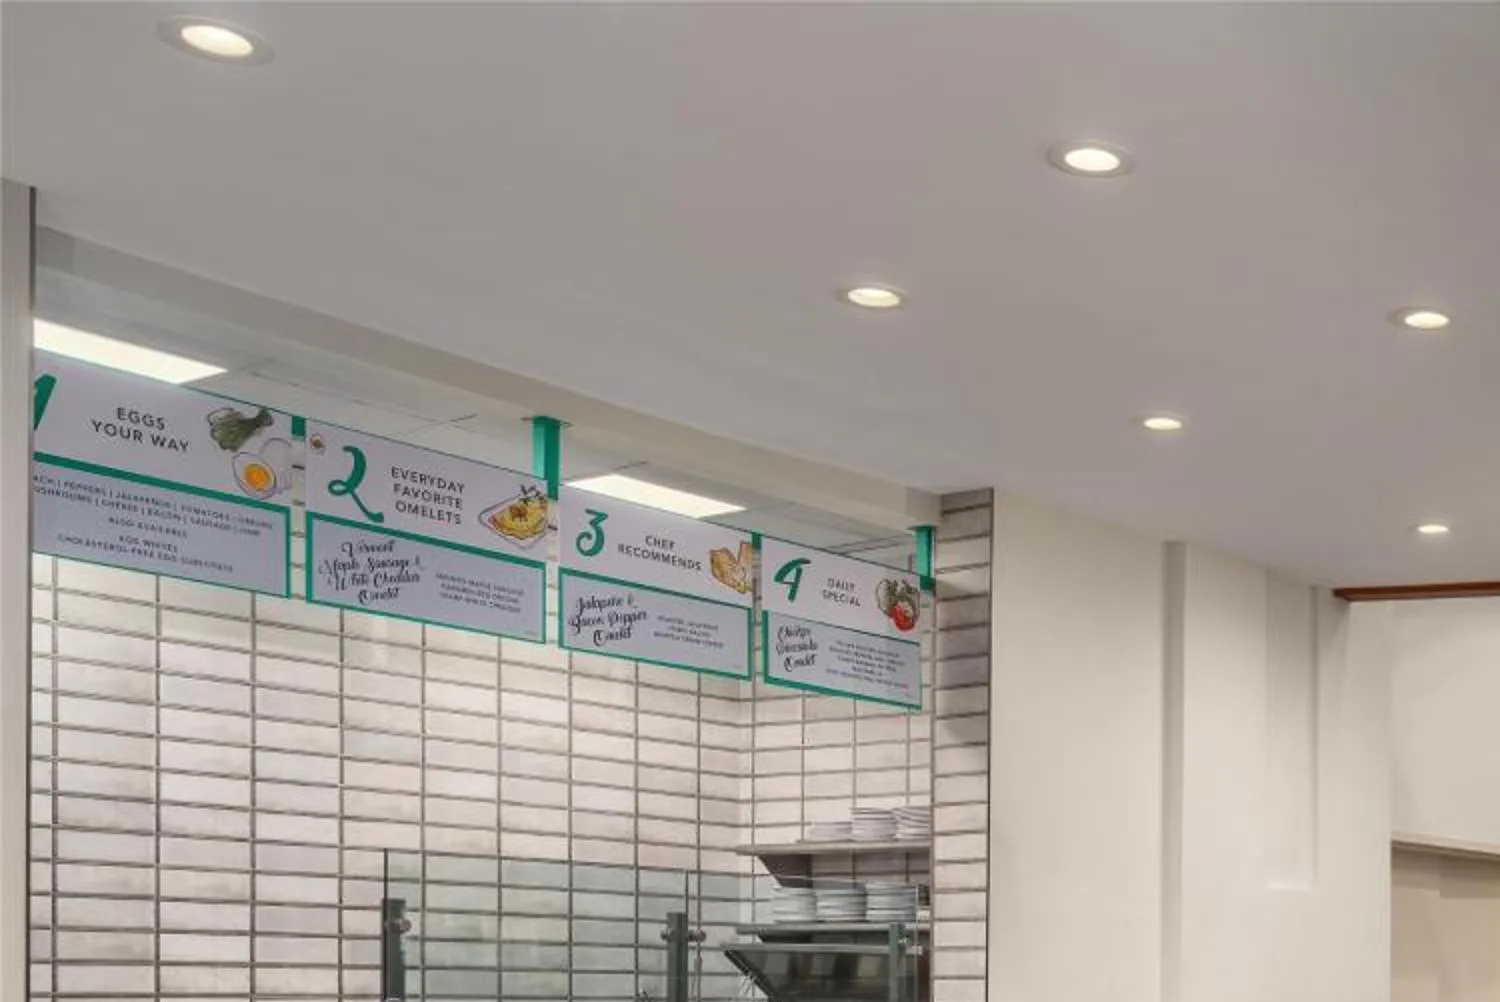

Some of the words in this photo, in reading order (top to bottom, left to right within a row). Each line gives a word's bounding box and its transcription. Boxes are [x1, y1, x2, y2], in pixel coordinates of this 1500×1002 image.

[116, 406, 166, 431] EGGS
[90, 419, 144, 444] YOUR
[150, 434, 190, 453] WAY
[327, 445, 385, 523] 2
[391, 466, 466, 493] EVERYDAY
[393, 482, 464, 510] FAVORITE
[395, 500, 463, 525] OMELETS
[576, 508, 609, 557] 3
[645, 535, 676, 550] CHEF
[617, 543, 702, 571] RECOMMENDS
[773, 557, 811, 602] 4
[827, 576, 855, 591] DAILY
[822, 590, 861, 607] SPECIAL
